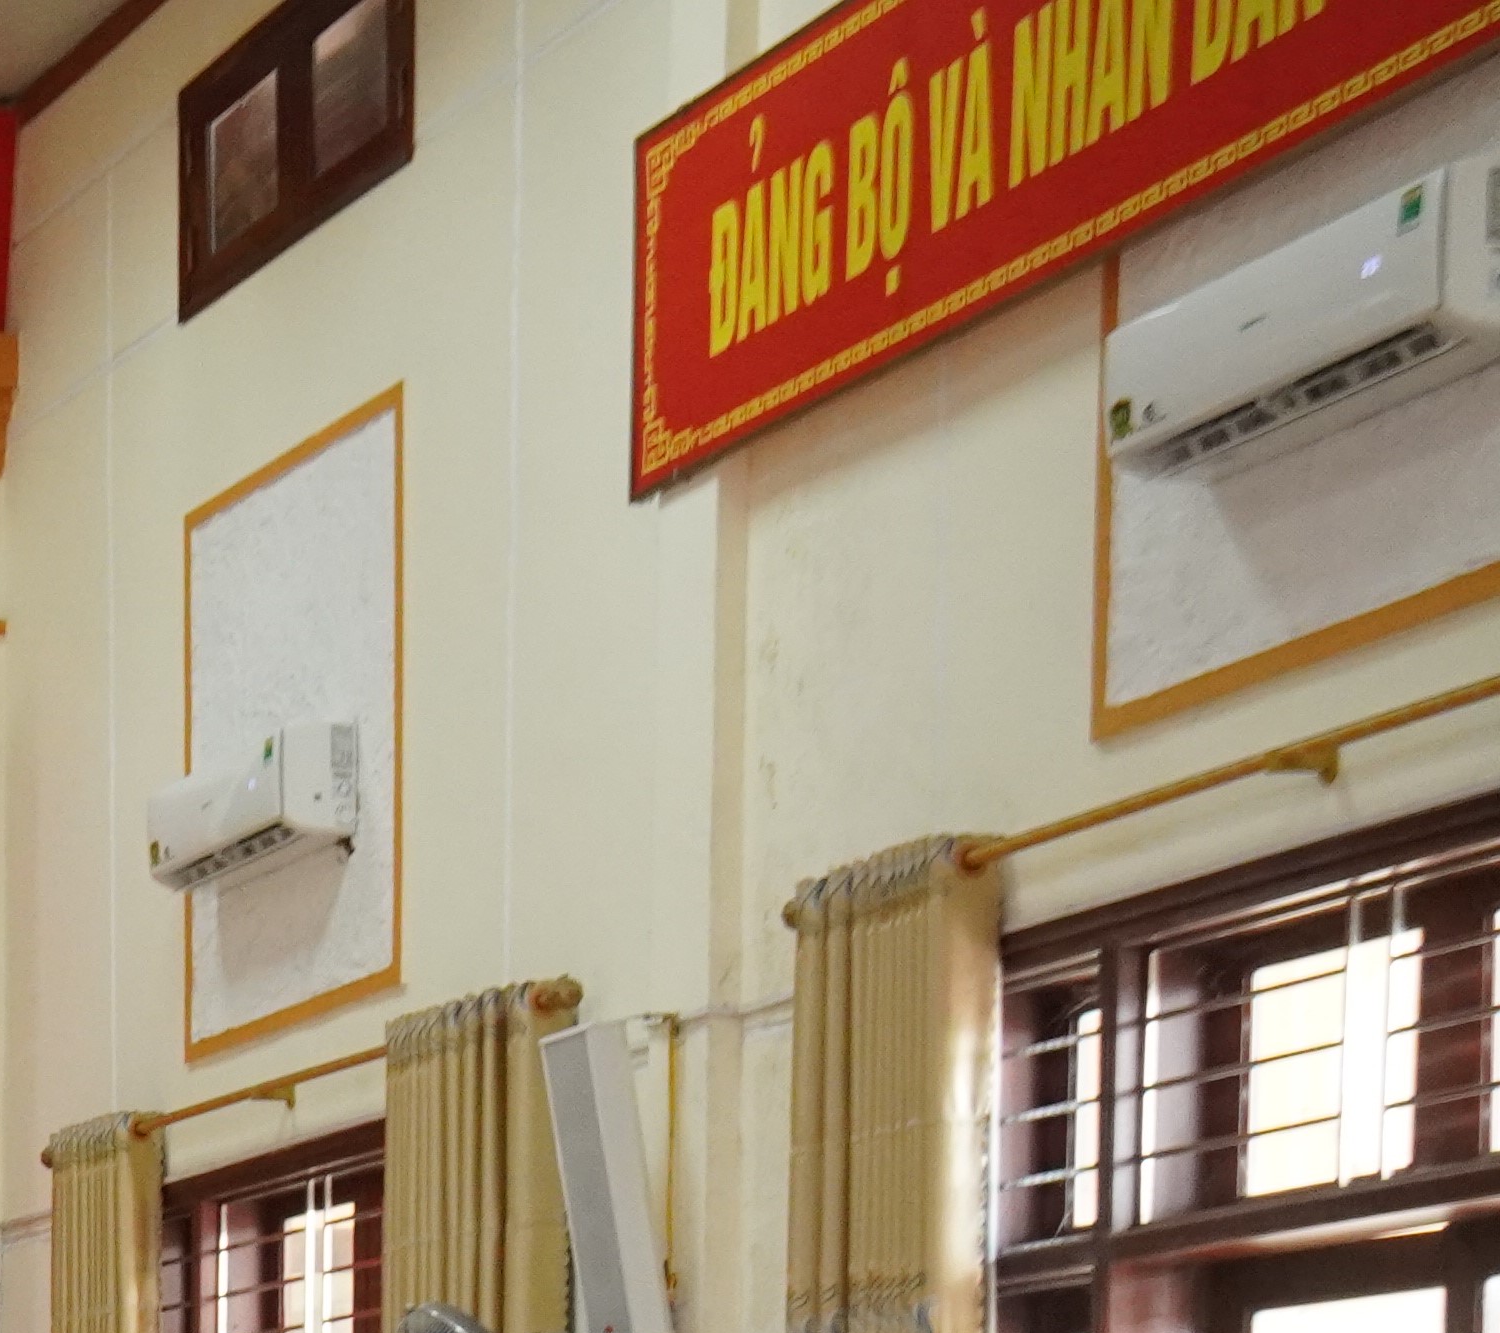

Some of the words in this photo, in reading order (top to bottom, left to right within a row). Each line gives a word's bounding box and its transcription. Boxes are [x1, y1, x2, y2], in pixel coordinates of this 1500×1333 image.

[708, 113, 833, 358] ĐẢNG
[845, 58, 914, 295] BỘ
[928, 5, 994, 234] VÀ
